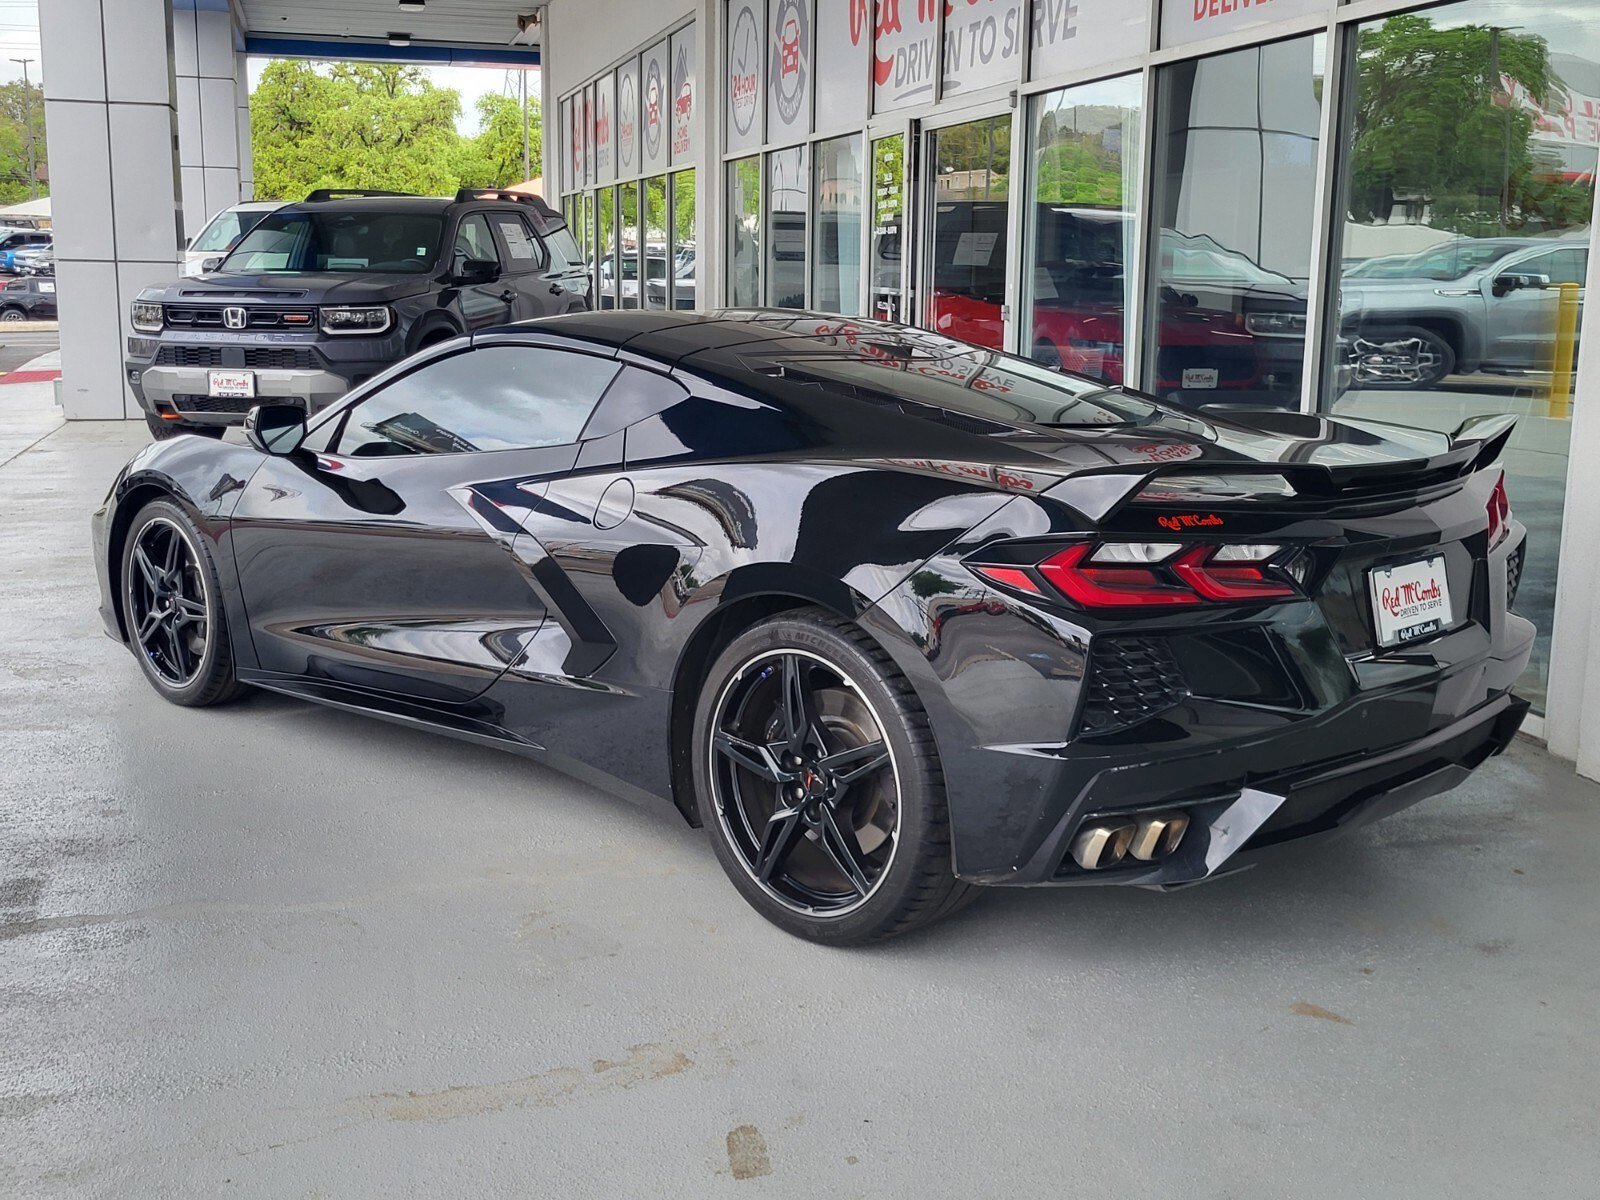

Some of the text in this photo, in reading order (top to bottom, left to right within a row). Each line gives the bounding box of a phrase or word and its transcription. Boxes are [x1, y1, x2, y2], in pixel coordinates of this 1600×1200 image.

[895, 27, 963, 88] DRIVN
[969, 15, 997, 68] TO
[1158, 514, 1224, 531] Red McCombs
[1382, 578, 1442, 617] Red McCombs
[1401, 599, 1442, 617] DRIVEN TO SERVE
